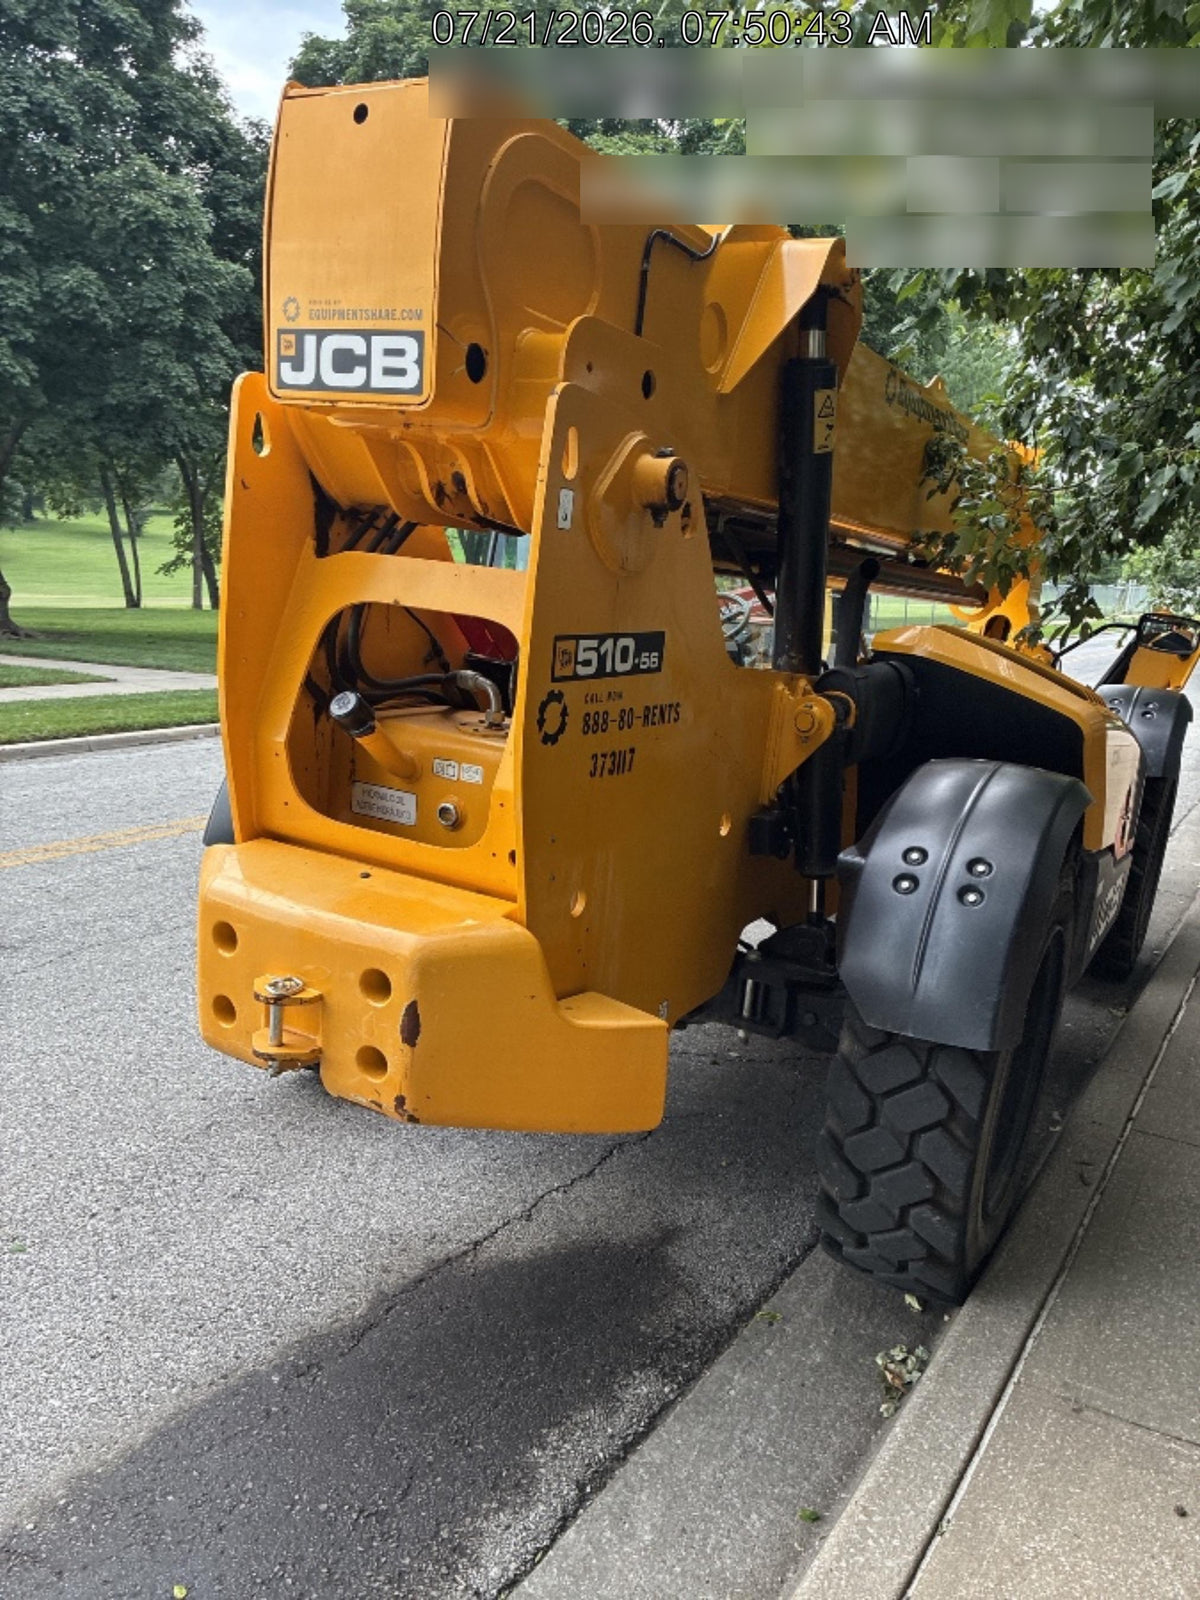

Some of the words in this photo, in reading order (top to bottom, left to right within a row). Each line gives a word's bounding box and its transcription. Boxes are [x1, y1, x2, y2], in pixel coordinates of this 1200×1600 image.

[309, 308, 423, 321] EQUIPMENTSHARE.COM
[280, 334, 420, 389] JCB
[583, 703, 681, 735] 888-80-RENTS
[589, 748, 636, 778] 373117
